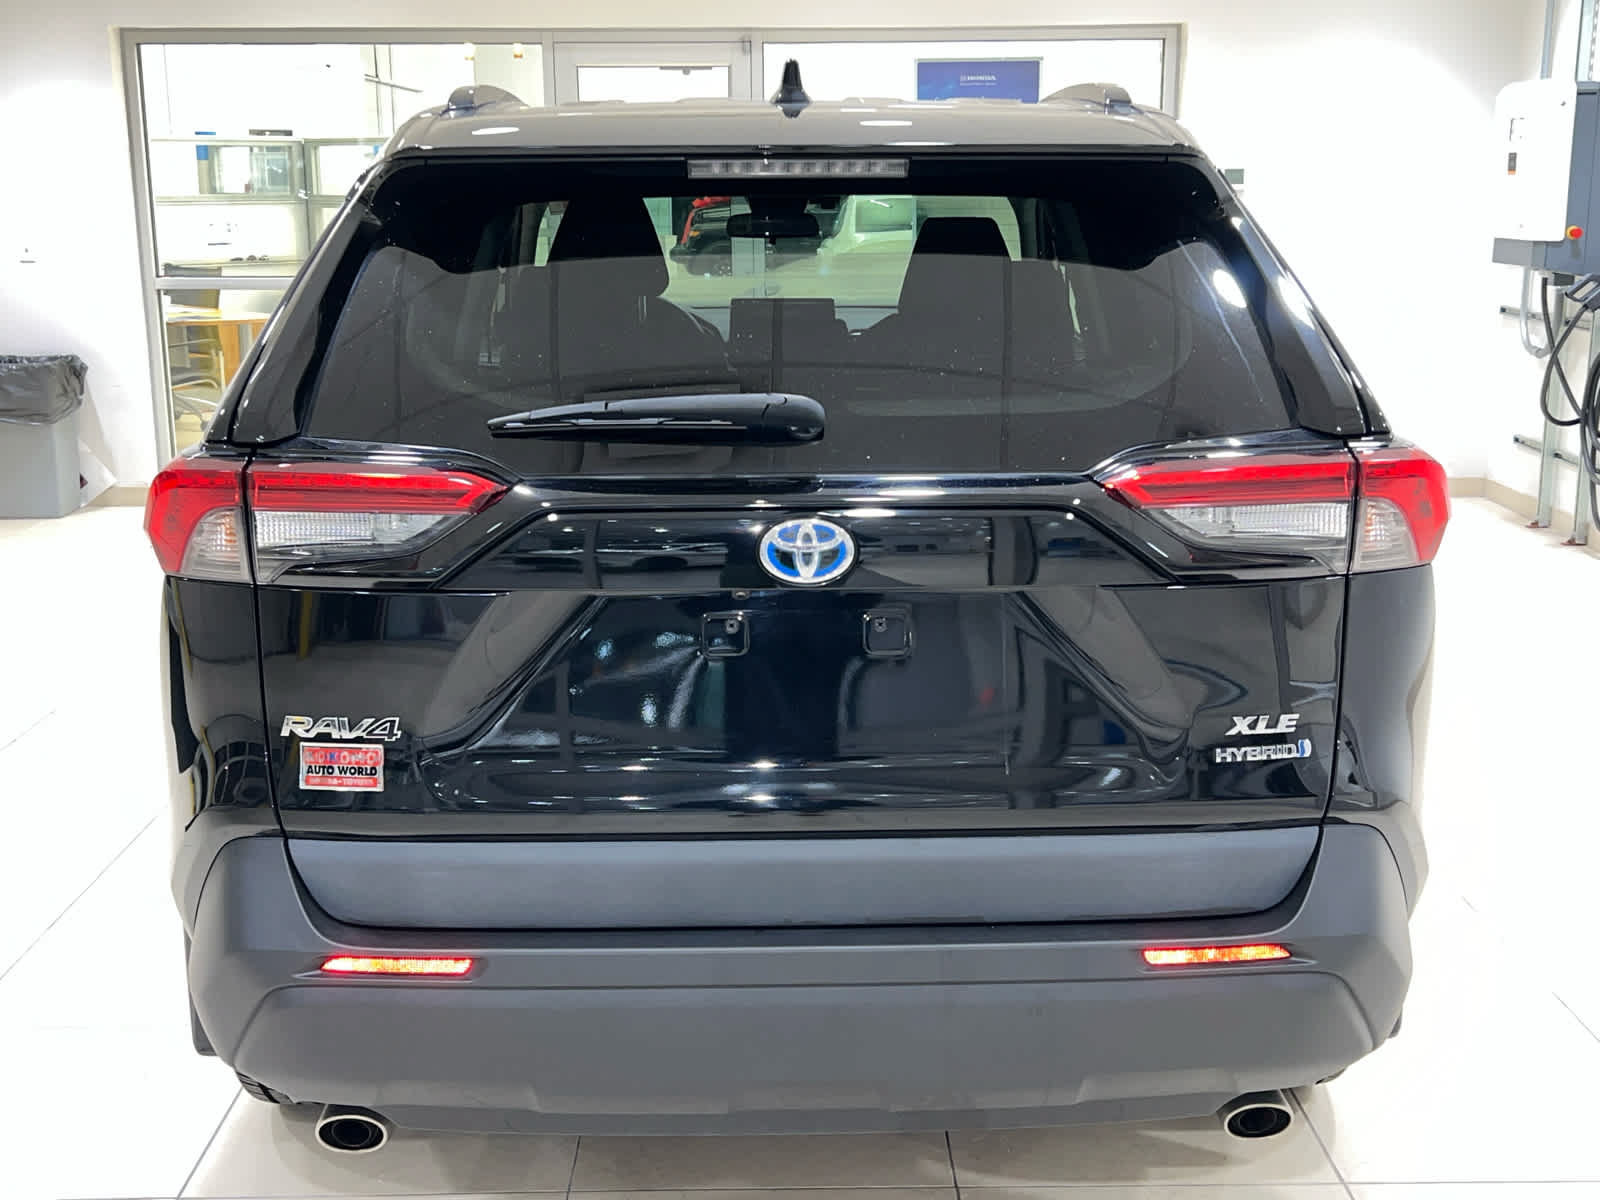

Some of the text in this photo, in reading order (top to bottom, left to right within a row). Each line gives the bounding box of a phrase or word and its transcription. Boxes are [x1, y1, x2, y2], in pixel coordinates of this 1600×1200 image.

[280, 715, 402, 741] RAV4
[1224, 713, 1300, 736] XLE
[1215, 743, 1298, 763] HYBRID
[306, 765, 378, 776] AUTO WORLD
